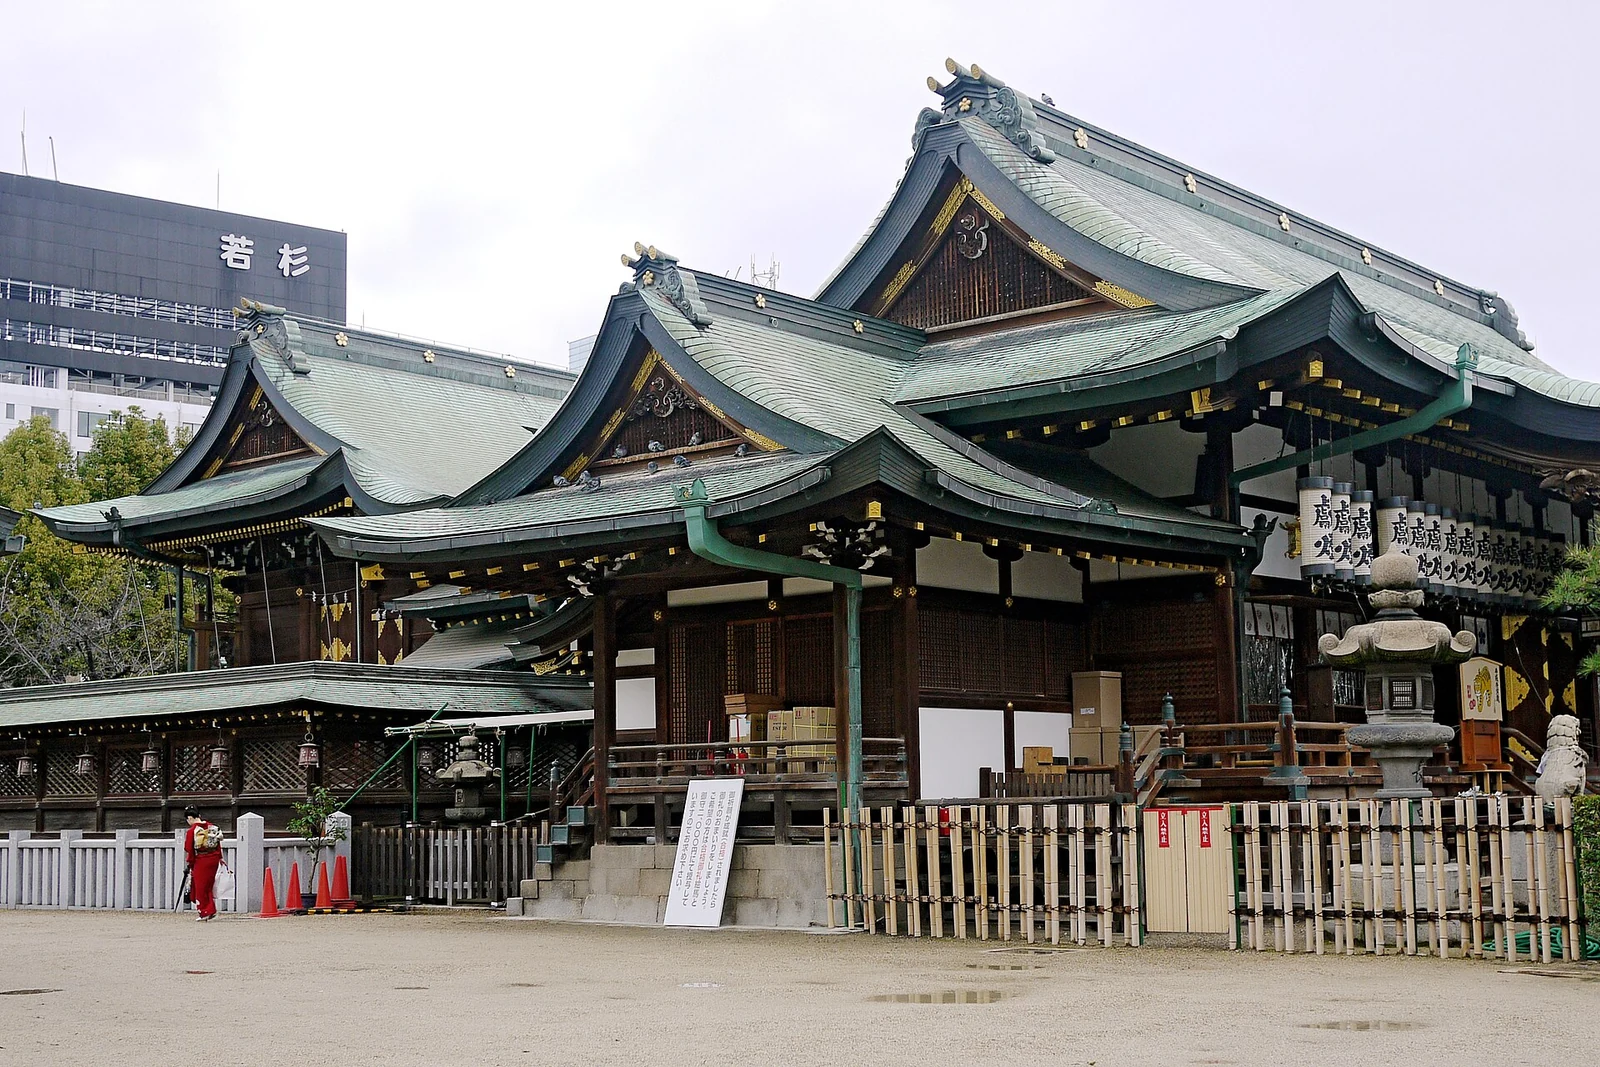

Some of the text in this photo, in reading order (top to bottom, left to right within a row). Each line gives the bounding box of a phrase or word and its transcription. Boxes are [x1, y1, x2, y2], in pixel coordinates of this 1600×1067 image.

[220, 233, 310, 277] 若杉
[1201, 811, 1209, 843] 立入禁止
